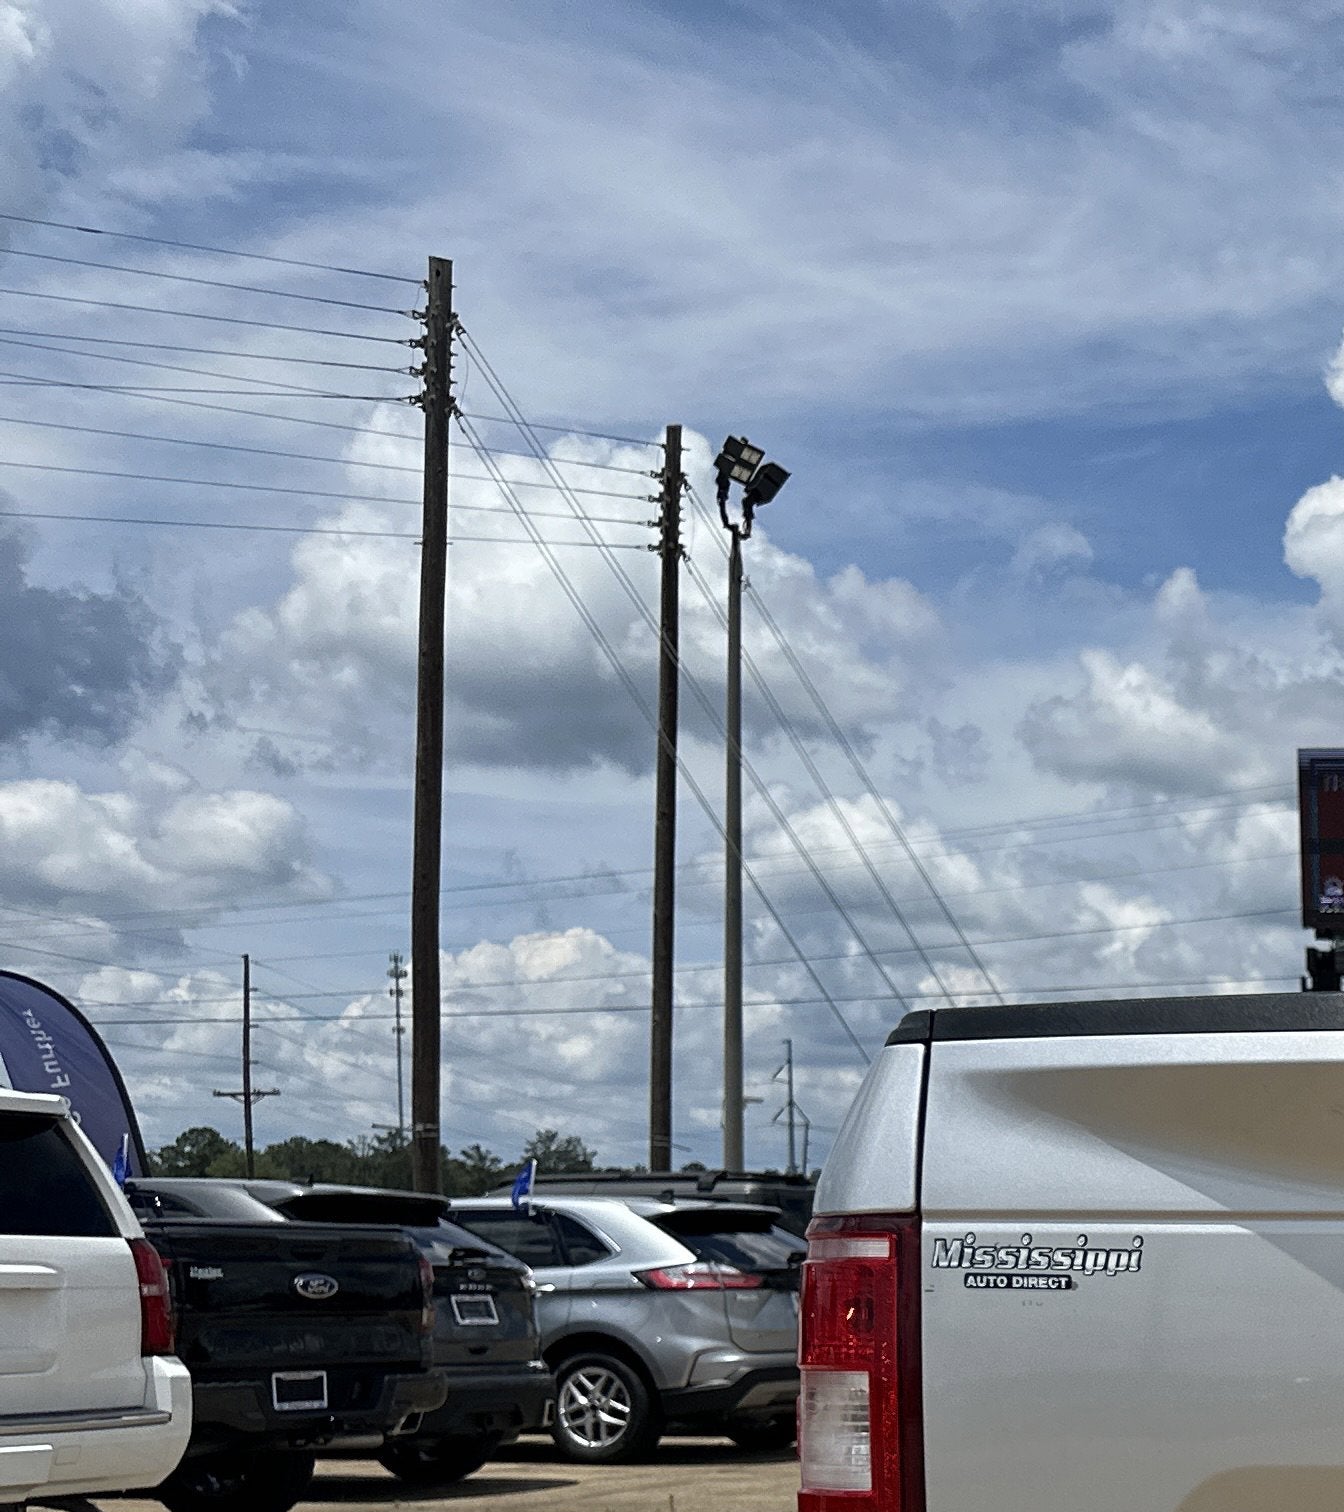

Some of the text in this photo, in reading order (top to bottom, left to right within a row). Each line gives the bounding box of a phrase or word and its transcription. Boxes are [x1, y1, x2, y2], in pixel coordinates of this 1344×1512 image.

[931, 1232, 1144, 1276] Mississippi
[965, 1275, 1069, 1289] AUTO DIRECT
